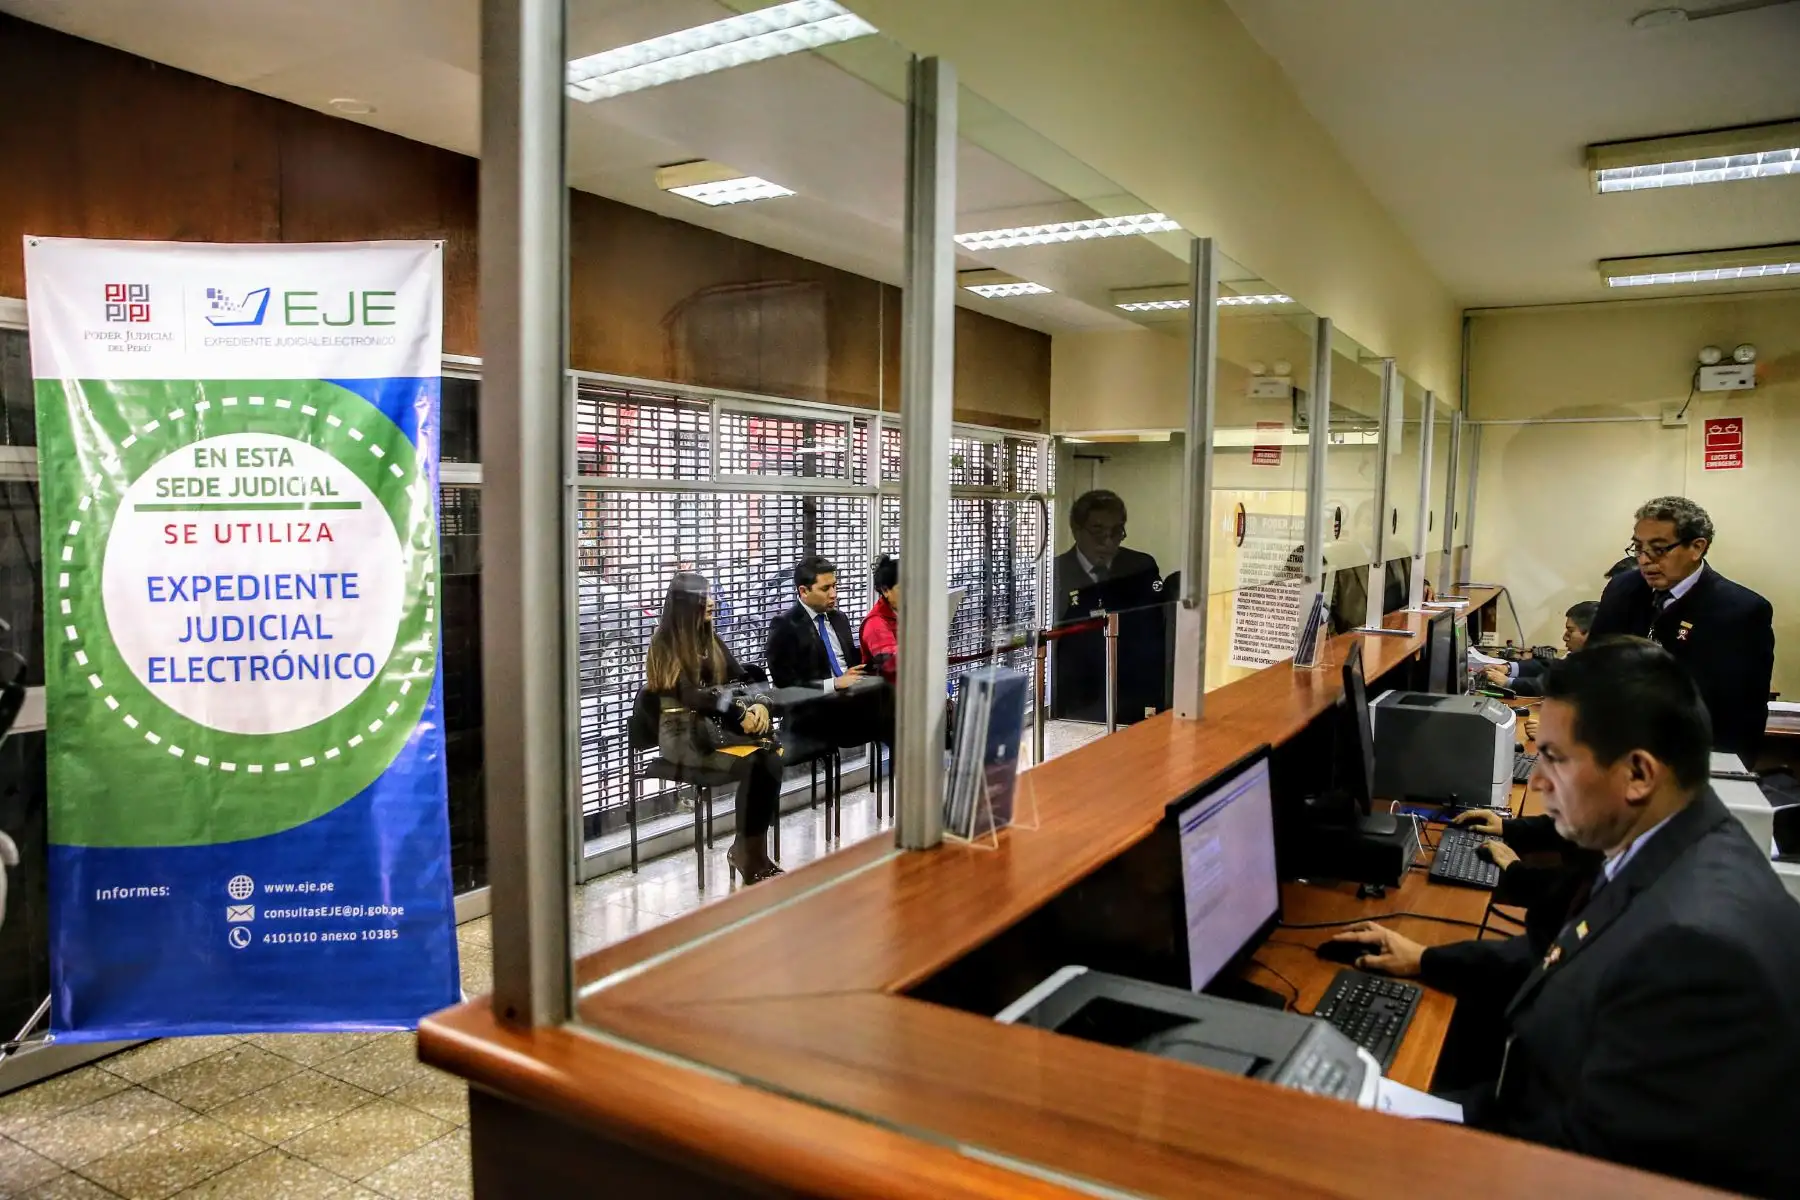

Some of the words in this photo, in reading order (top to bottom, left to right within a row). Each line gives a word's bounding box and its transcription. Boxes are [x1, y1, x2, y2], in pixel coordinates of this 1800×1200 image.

[284, 291, 396, 326] EJE
[84, 329, 122, 340] PODER
[124, 329, 176, 343] JUDICIAL
[204, 336, 272, 347] EXPEDIENTE
[274, 336, 320, 347] JUDICIAL
[194, 447, 227, 468] EN
[236, 447, 294, 467] ESTA
[156, 477, 221, 497] SEDE
[228, 476, 339, 497] JUDICIAL
[164, 523, 198, 544] SE
[214, 522, 334, 543] UTILIZA
[147, 572, 360, 602] EXPEDIENTE
[178, 613, 334, 643] JUDICIAL
[148, 649, 376, 683] ELECTRÓNICO
[96, 885, 170, 901] Informes:
[264, 881, 335, 895] www.eje.pe
[263, 904, 405, 920] consultasEJE@pj.gob.pe
[263, 932, 317, 945] 4101010
[320, 931, 357, 942] anexo
[361, 928, 399, 941] 10385
